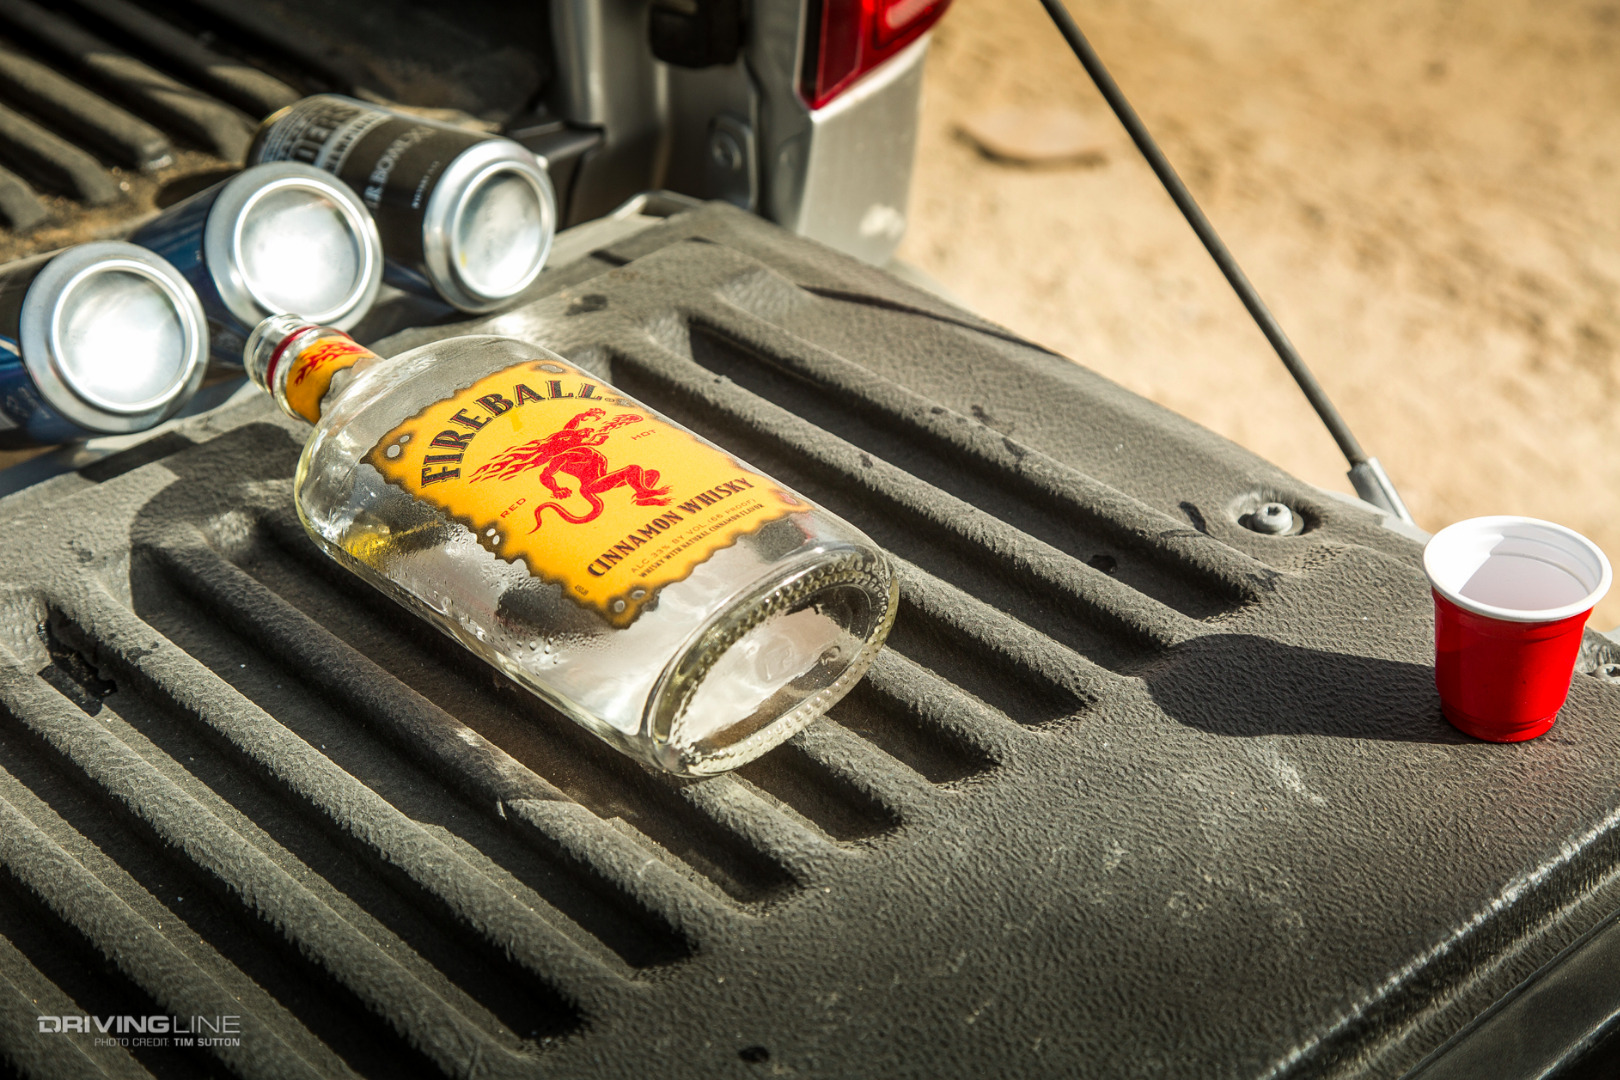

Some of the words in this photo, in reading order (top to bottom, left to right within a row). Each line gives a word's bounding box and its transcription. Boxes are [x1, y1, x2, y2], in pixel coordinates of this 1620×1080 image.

[421, 380, 603, 488] FIREBALL
[631, 429, 656, 441] HOT
[500, 498, 526, 519] RED
[586, 510, 684, 577] CINNAMON
[677, 477, 755, 514] WHISKY
[638, 558, 665, 578] WHISKY
[663, 546, 683, 561] WITH
[680, 530, 711, 550] NATURAL
[708, 513, 742, 532] CINNAMON
[738, 503, 765, 517] FLAVOR
[671, 535, 685, 545] BY
